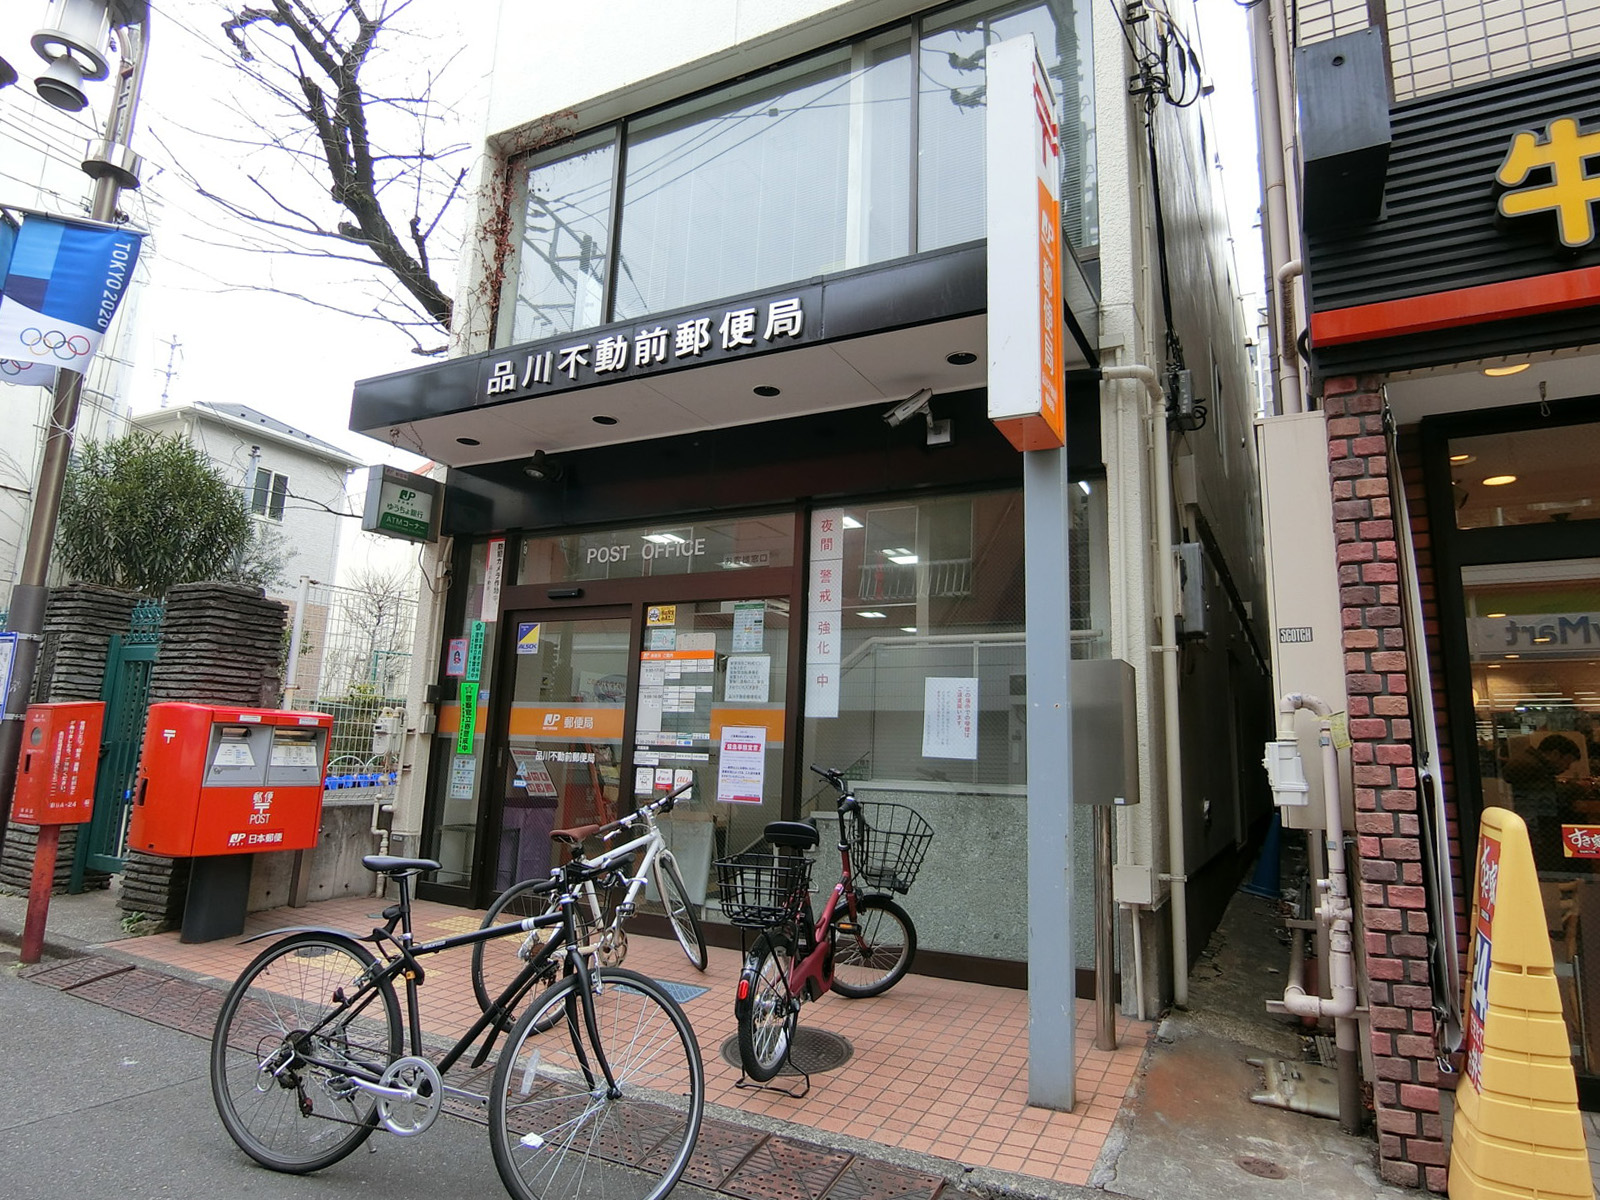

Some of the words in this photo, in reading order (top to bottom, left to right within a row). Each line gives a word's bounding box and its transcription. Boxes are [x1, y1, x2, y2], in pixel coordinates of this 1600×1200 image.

[1497, 116, 1600, 247] 牛
[106, 243, 131, 291] TOKYO
[97, 289, 118, 328] 2020
[487, 296, 804, 395] 品川不動前郵便局
[387, 503, 424, 519] ゆうちょ銀行
[386, 516, 425, 530] ATMコーナー
[586, 545, 631, 564] POST
[641, 538, 706, 560] OFFICE
[816, 518, 834, 688] 夜間警戒強化中
[1280, 628, 1312, 643] SCOTCH
[543, 713, 561, 726] JP
[563, 716, 594, 729] 郵便局
[535, 750, 595, 764] 品川不動前郵便局
[253, 791, 274, 803] 郵便
[249, 813, 271, 825] POST
[248, 832, 283, 844] 日本郵便
[1472, 931, 1490, 1022] 24
